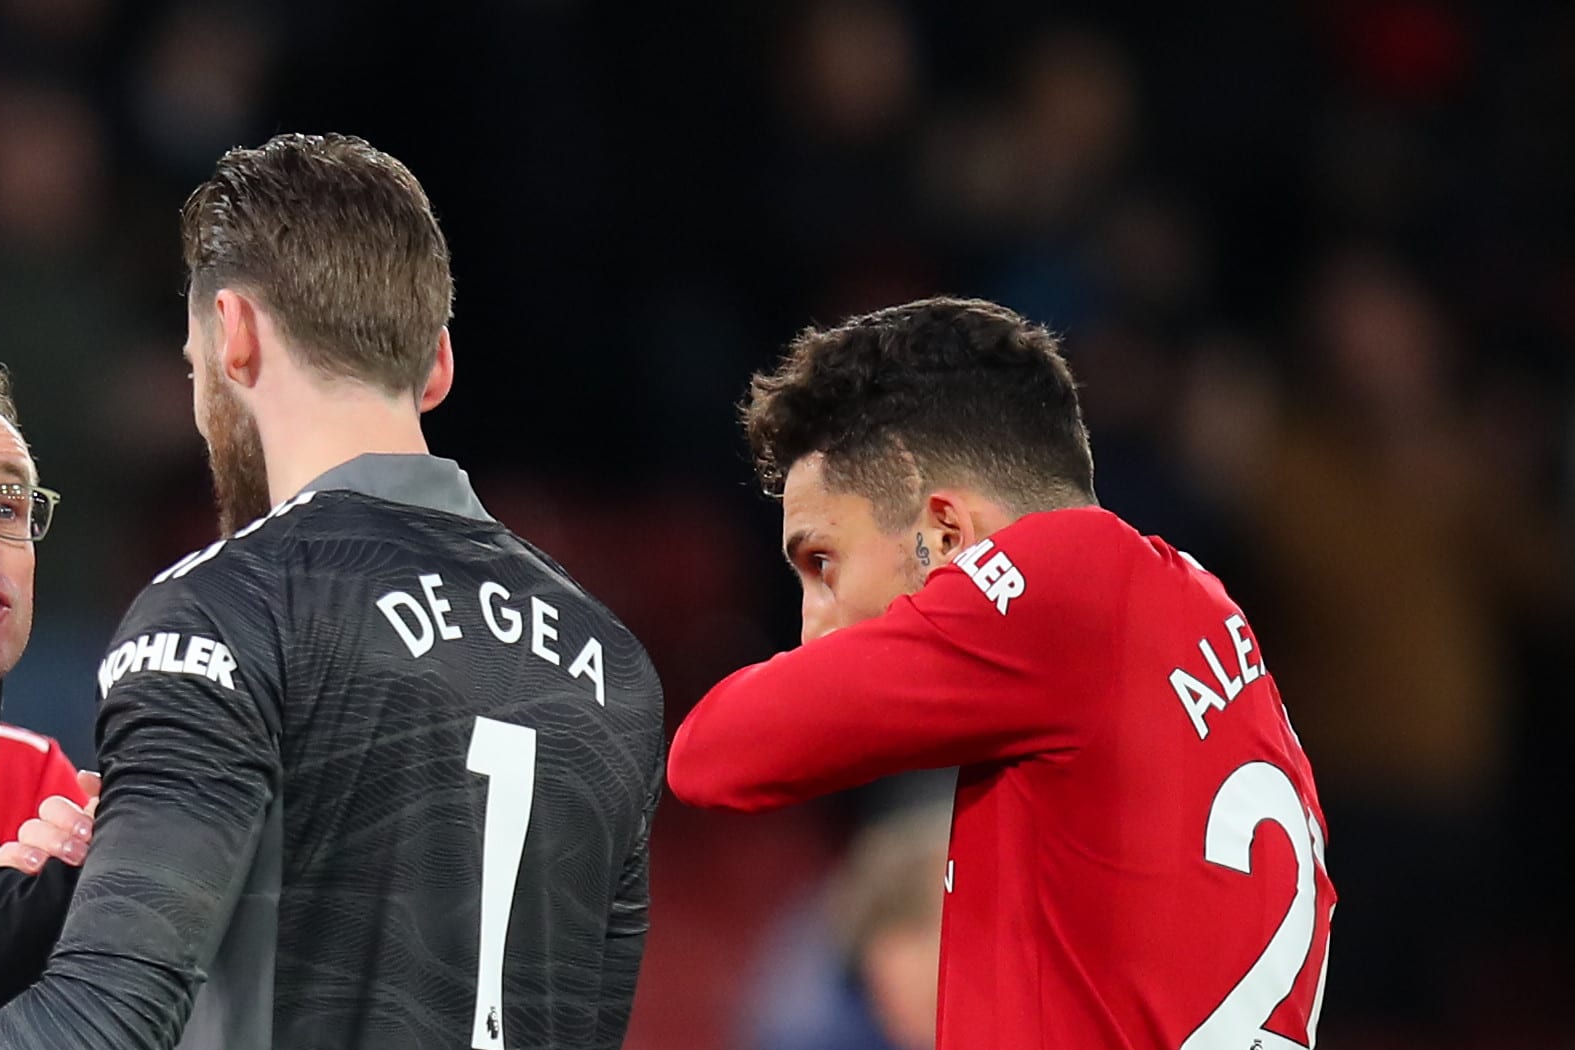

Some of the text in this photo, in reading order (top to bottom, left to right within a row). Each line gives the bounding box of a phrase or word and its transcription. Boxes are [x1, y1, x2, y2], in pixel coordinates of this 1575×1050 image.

[97, 632, 239, 700] KOHLER
[376, 573, 606, 708] DE GEA
[1168, 613, 1266, 741] ALE
